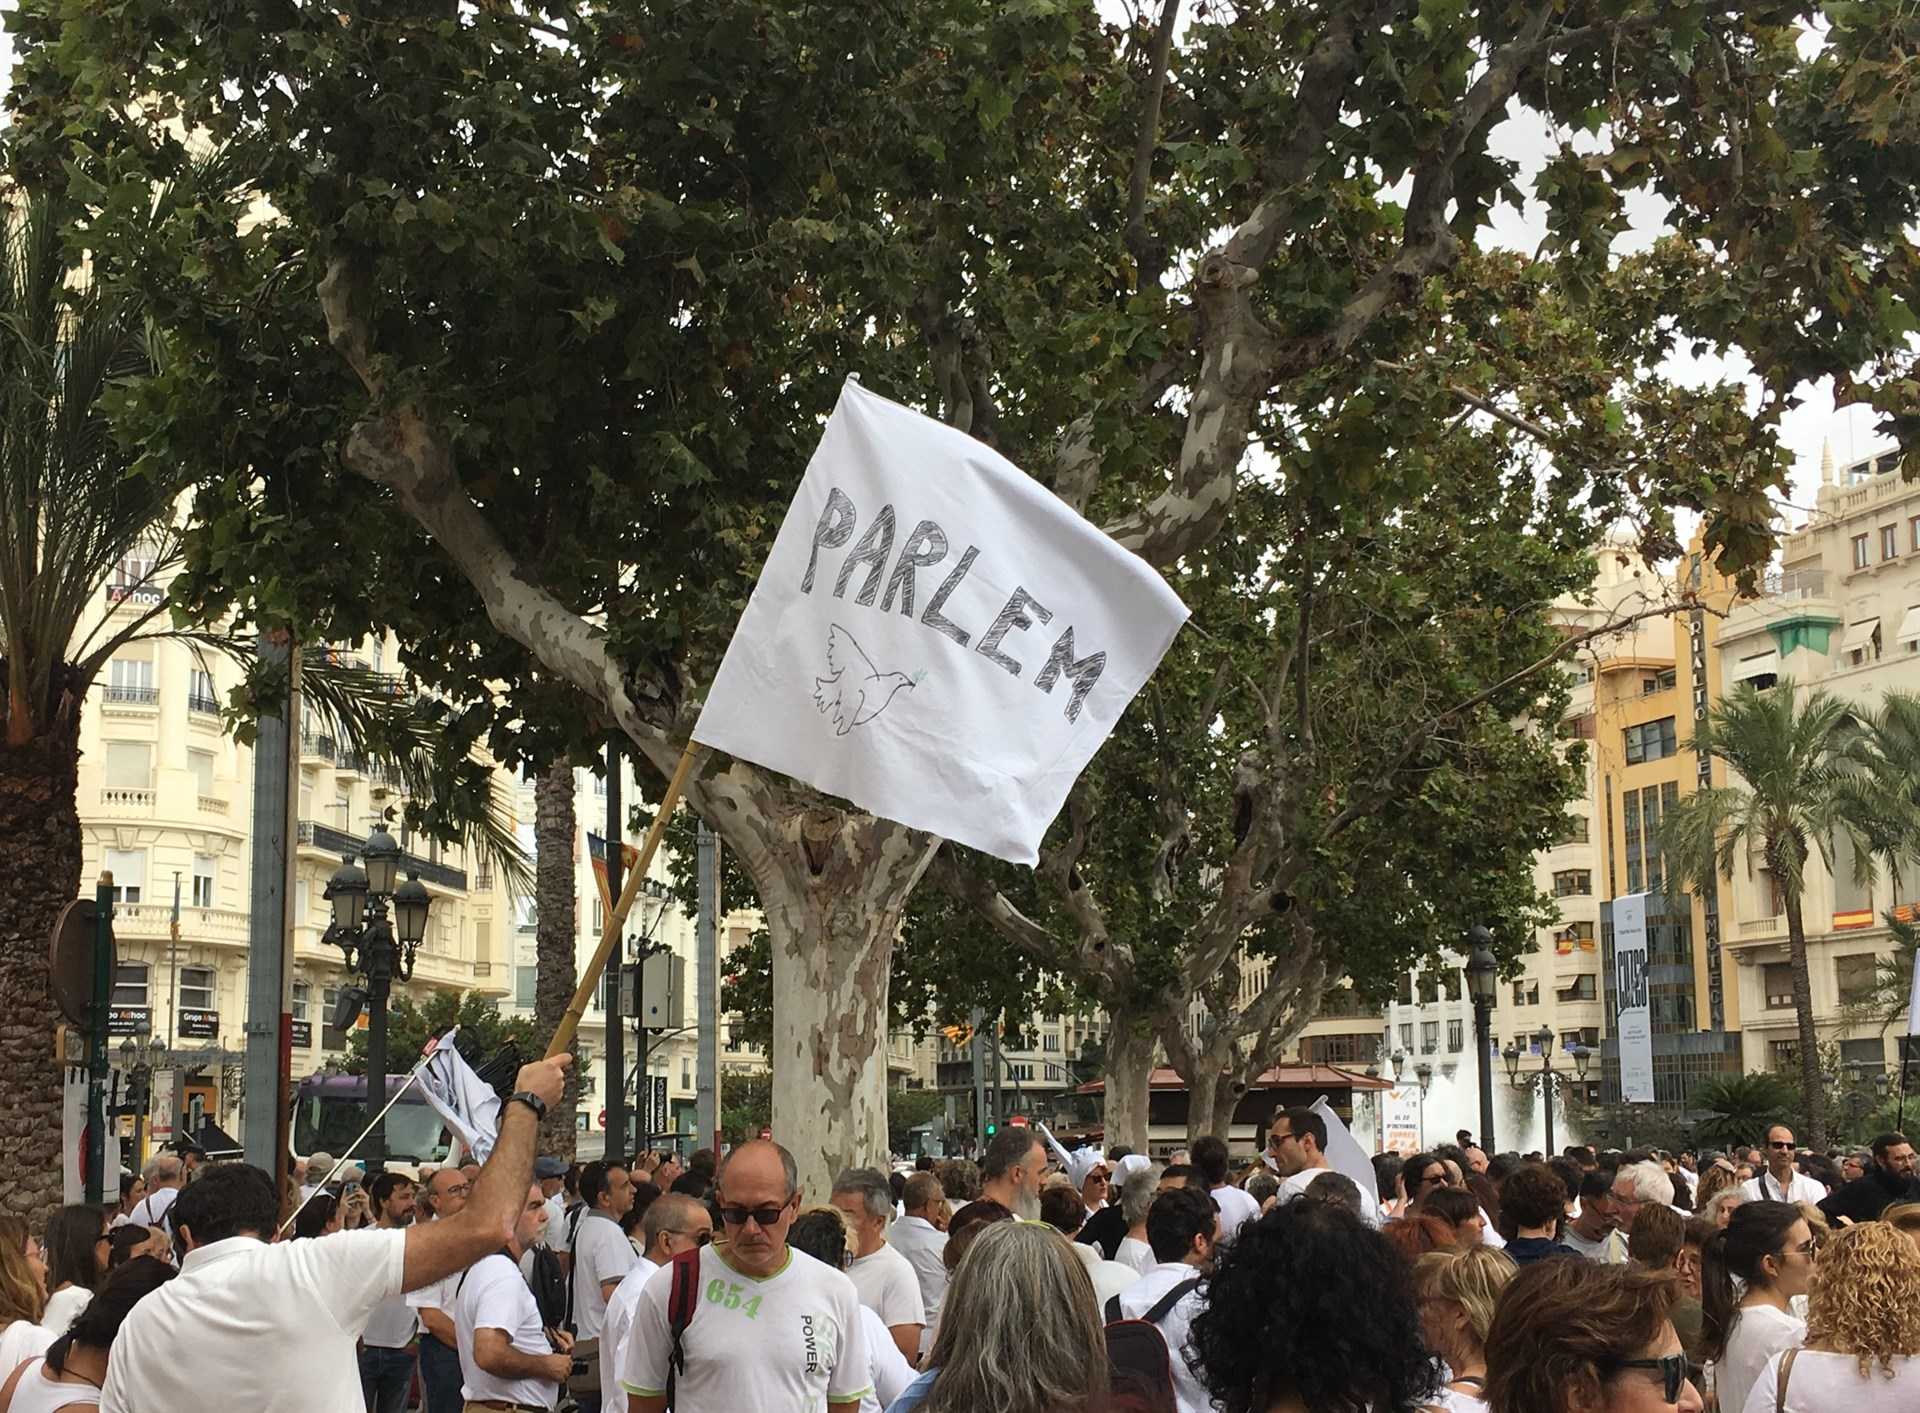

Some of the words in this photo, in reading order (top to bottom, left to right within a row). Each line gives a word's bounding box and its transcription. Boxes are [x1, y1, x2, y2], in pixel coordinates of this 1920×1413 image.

[111, 589, 160, 605] Ahoc
[801, 487, 1106, 724] PARLEM
[1690, 621, 1705, 720] RIALTO
[706, 1278, 763, 1320] 654
[801, 1315, 817, 1373] POWER
